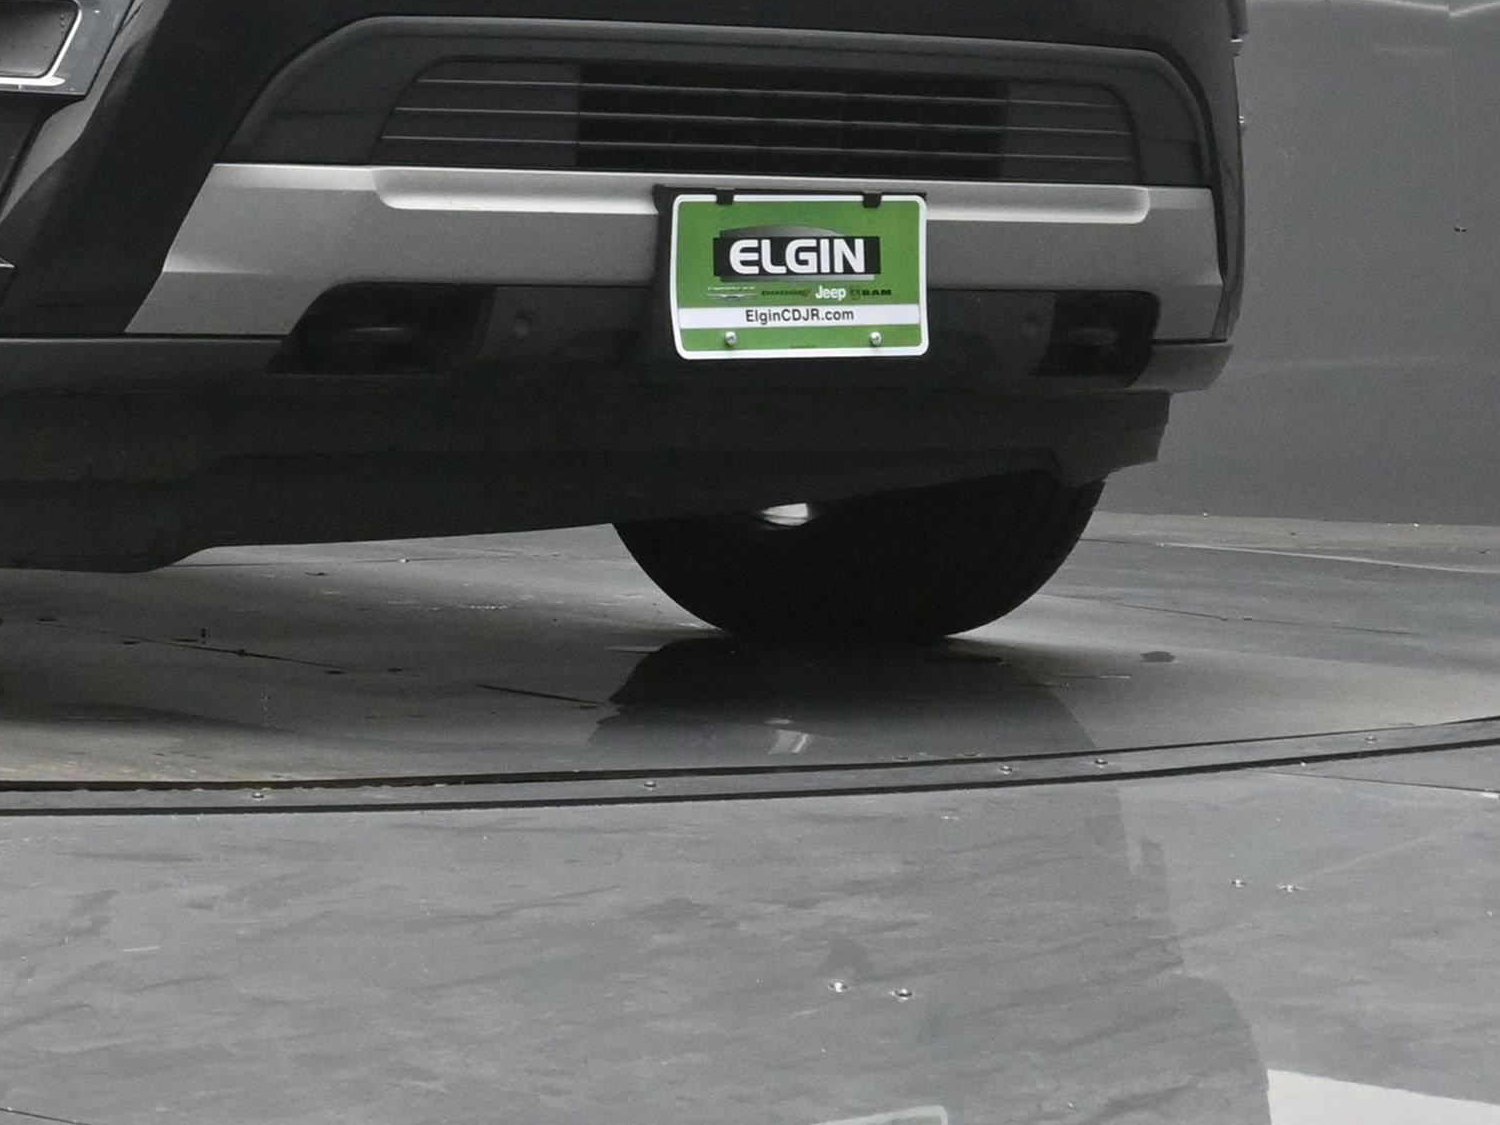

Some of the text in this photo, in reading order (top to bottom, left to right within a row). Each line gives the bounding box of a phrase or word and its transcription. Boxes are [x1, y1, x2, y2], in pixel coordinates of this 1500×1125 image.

[729, 238, 866, 275] ELGIN
[814, 285, 847, 301] Jeep
[862, 289, 892, 297] RAM
[745, 308, 855, 325] ElginCDJR.com
